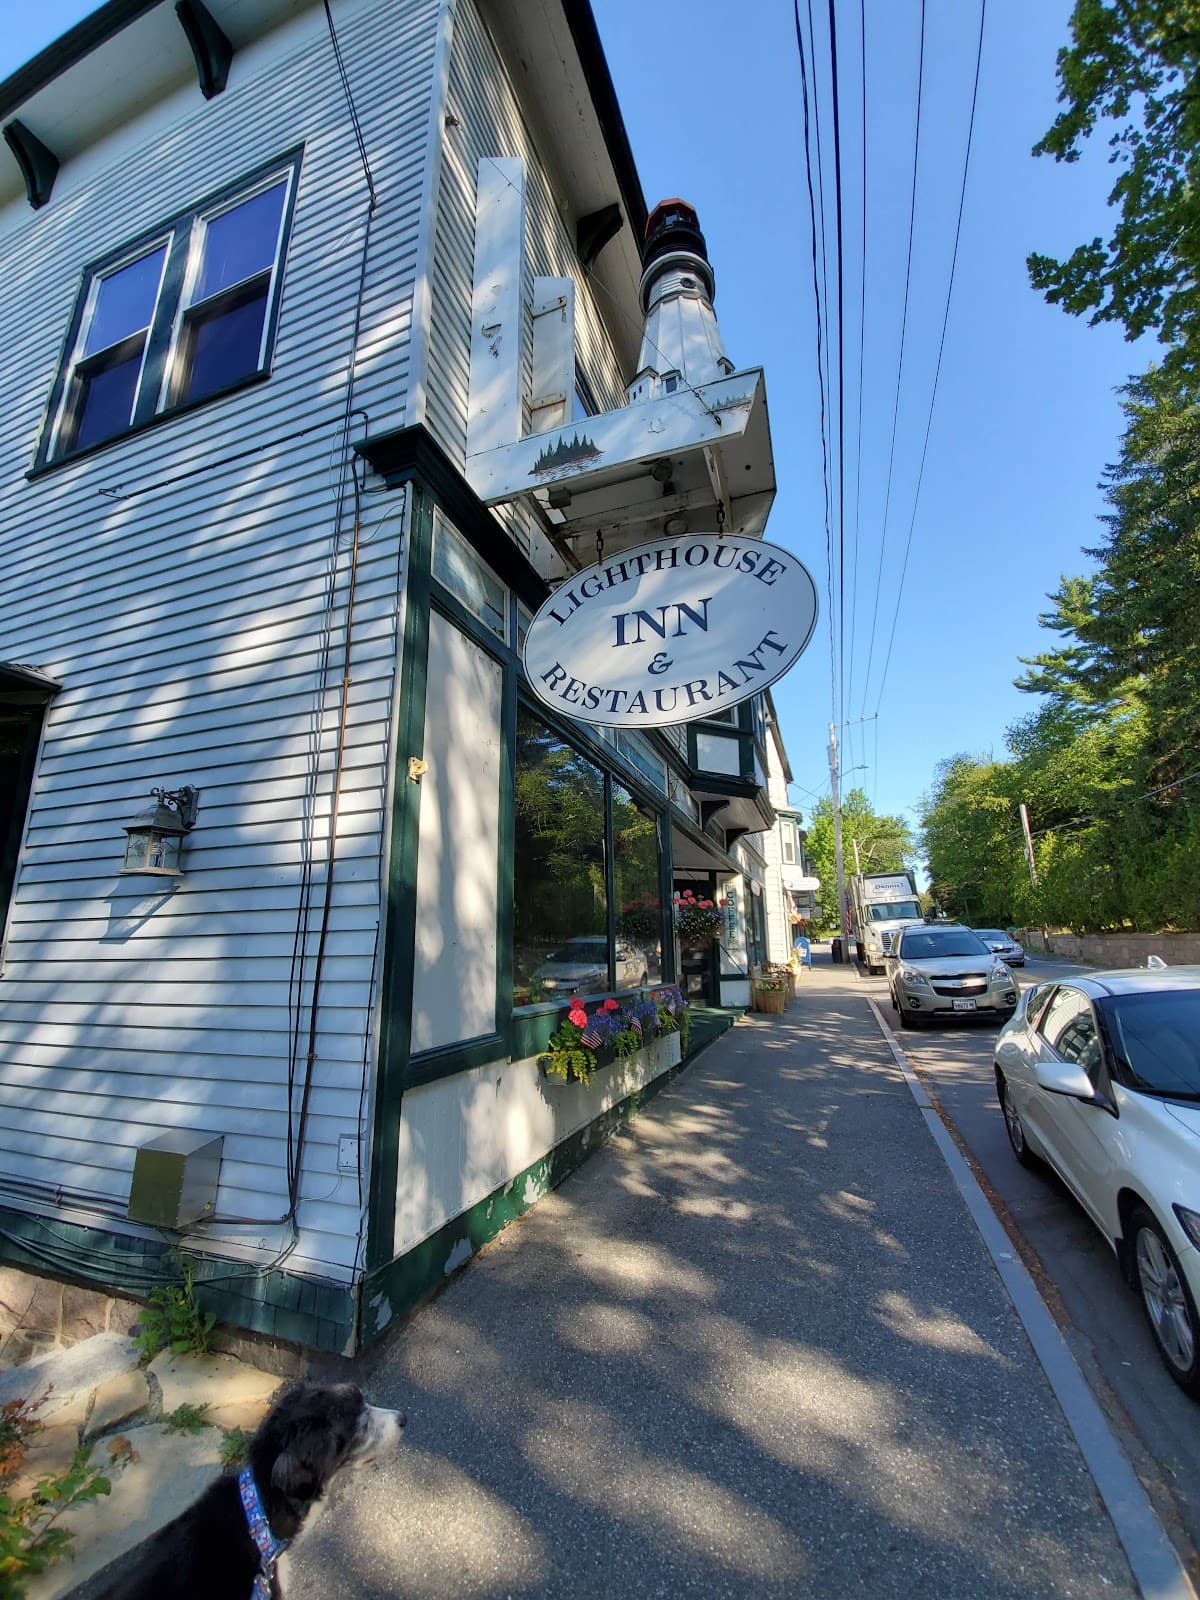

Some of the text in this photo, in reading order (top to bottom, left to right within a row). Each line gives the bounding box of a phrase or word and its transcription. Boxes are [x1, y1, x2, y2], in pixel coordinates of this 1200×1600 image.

[548, 544, 786, 626] LIGHTHOUSE
[612, 597, 713, 648] INN
[540, 630, 788, 714] RESTAURANT
[647, 652, 674, 675] &
[726, 891, 736, 939] COFFEE
